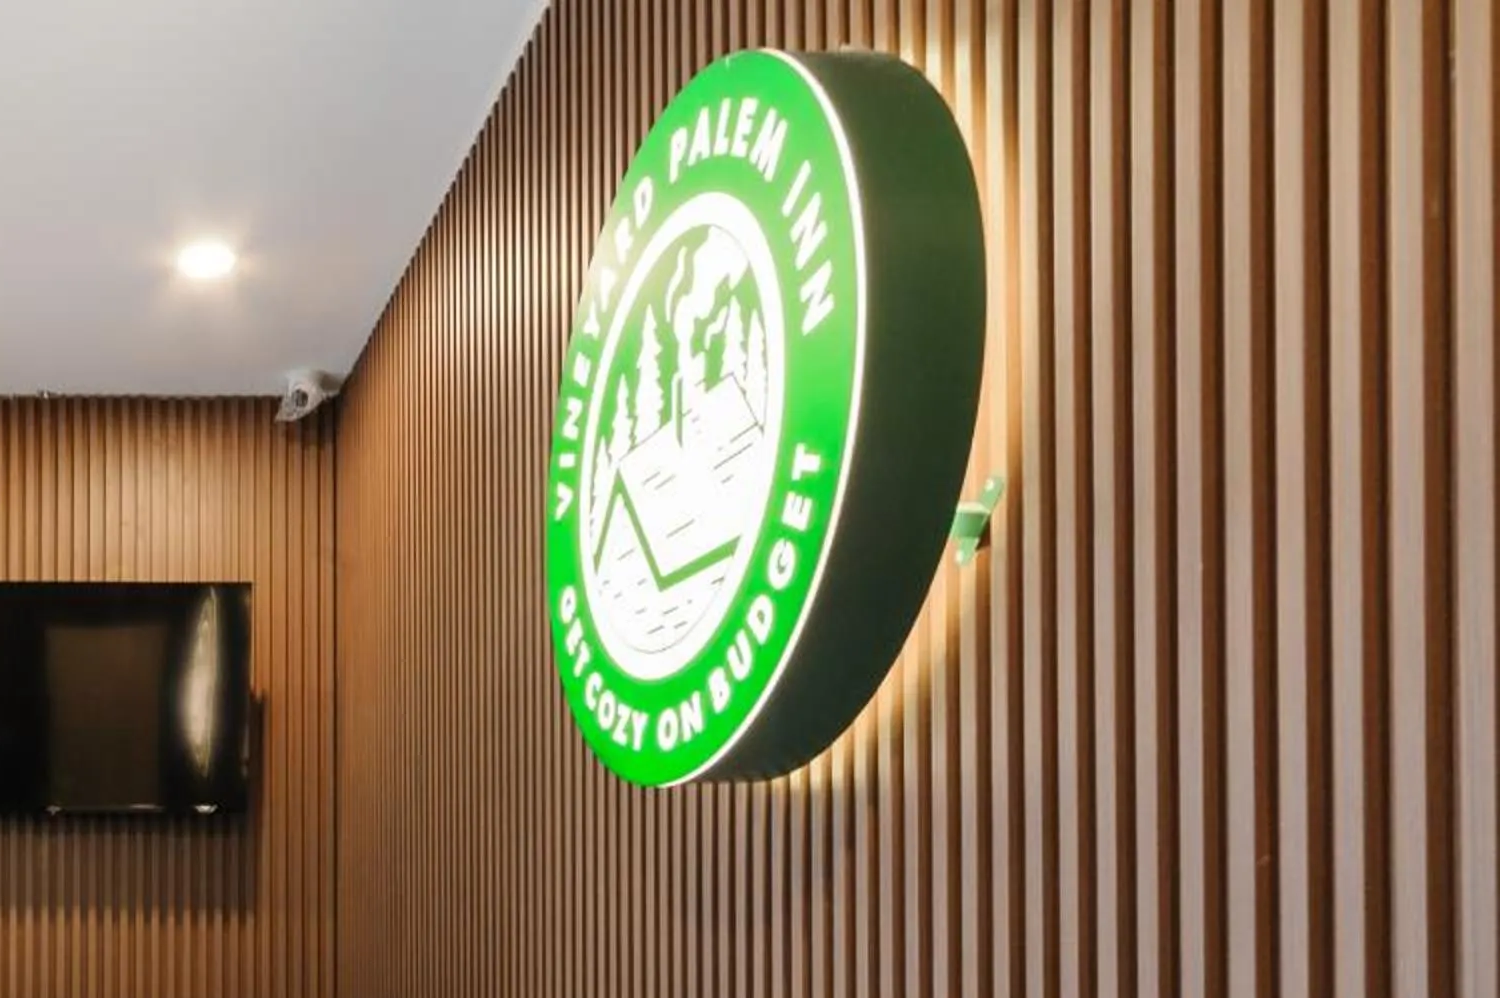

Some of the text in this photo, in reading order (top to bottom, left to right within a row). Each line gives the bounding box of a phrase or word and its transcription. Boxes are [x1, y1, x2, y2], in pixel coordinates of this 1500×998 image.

[555, 97, 835, 520] VINEYARD PALEM INN
[559, 443, 823, 752] GET COZY ON BUDGET
